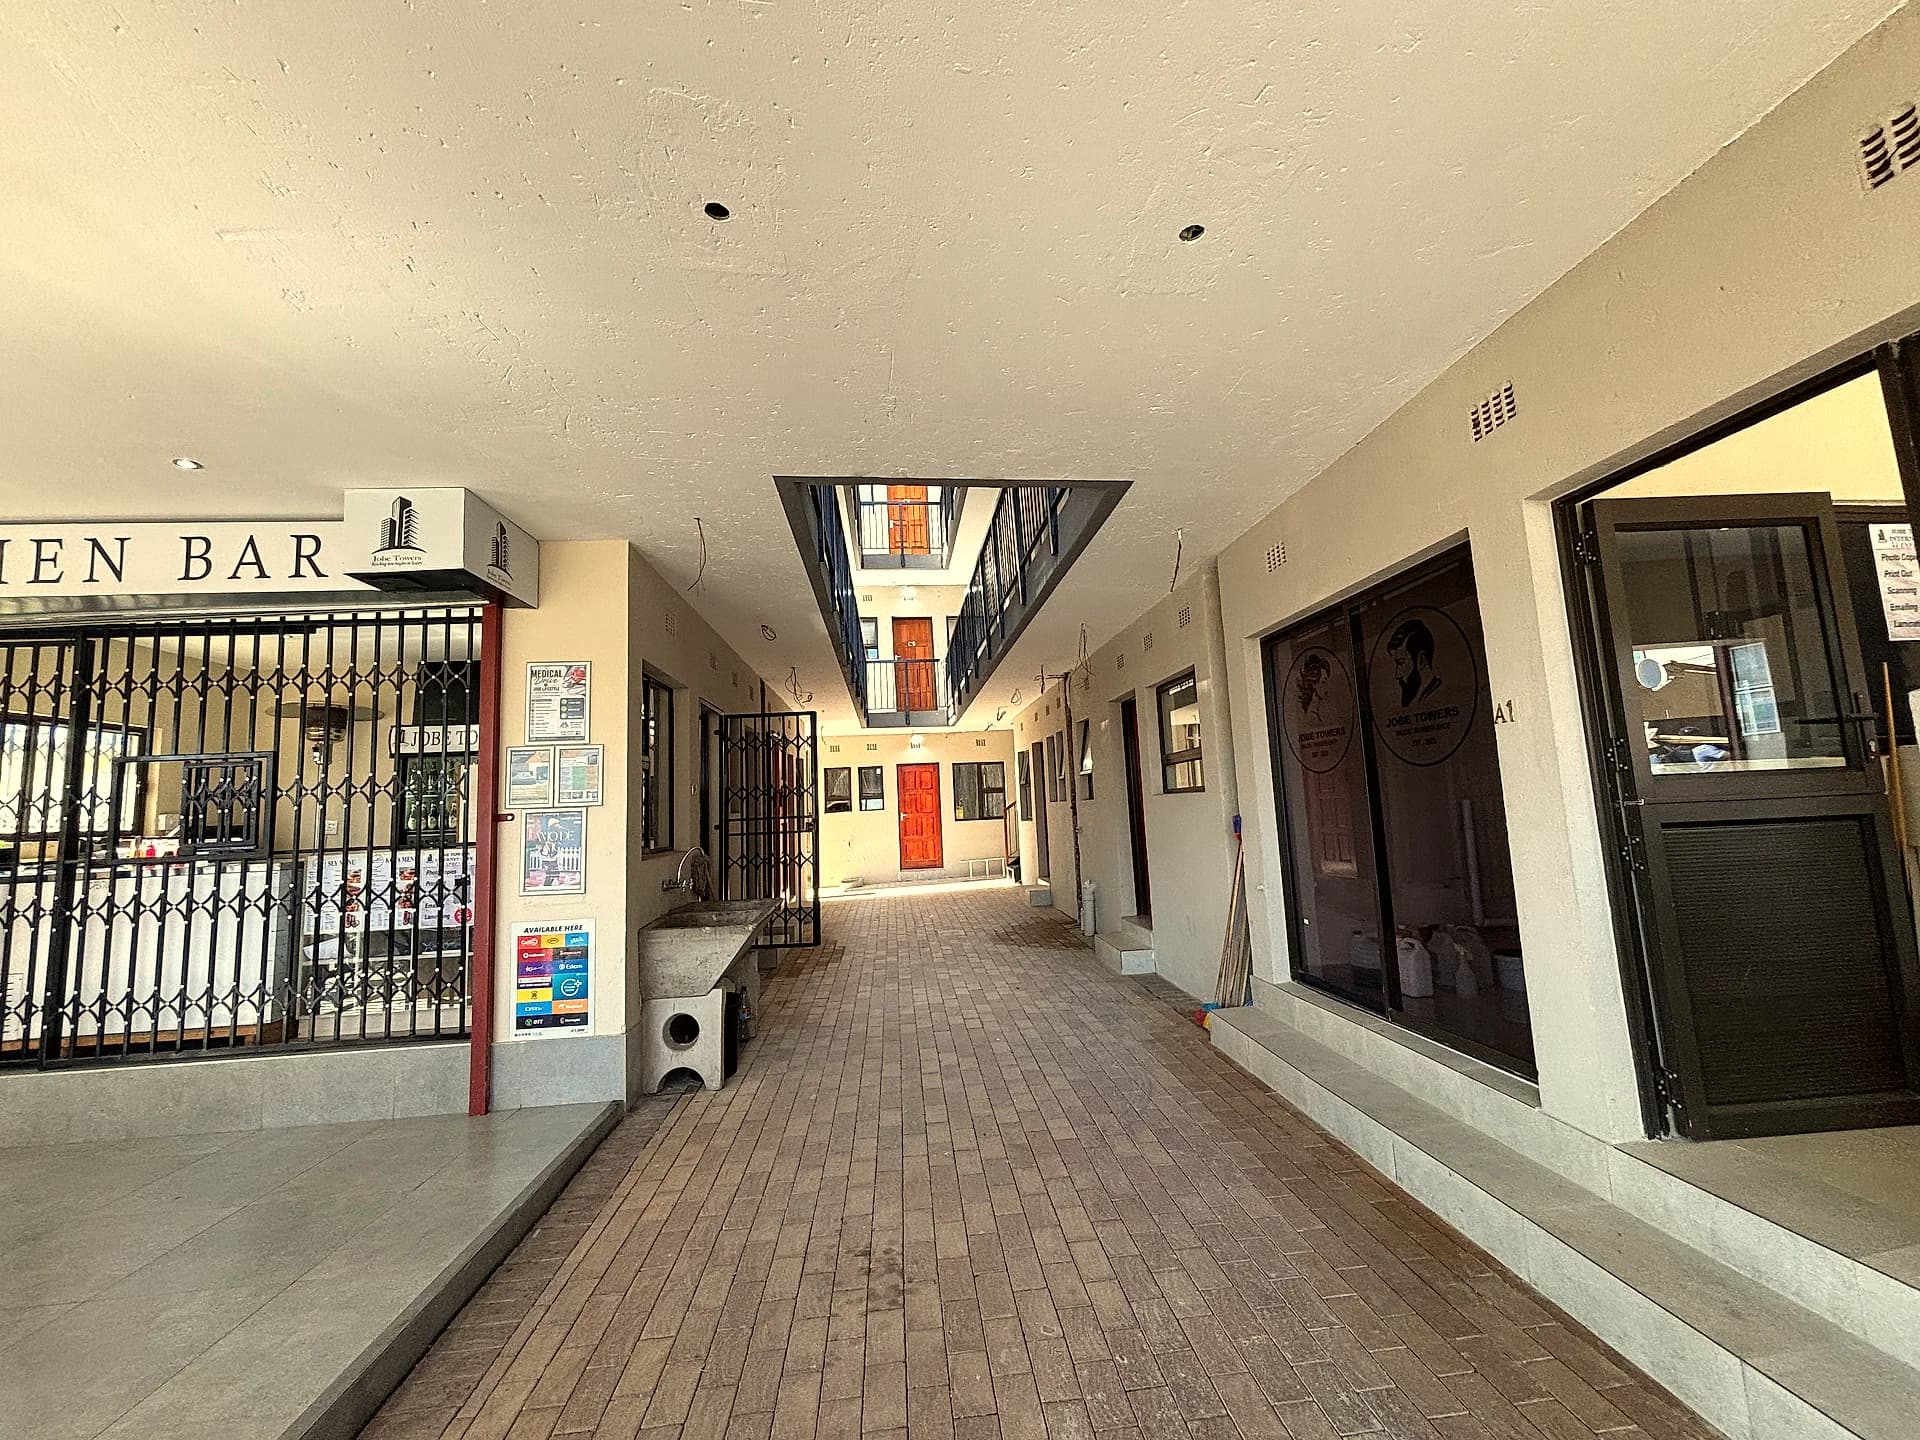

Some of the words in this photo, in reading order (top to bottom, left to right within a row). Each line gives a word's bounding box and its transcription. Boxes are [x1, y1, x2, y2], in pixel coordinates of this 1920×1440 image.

[177, 534, 329, 581] BAR
[1887, 586, 1917, 596] Scanning
[1889, 603, 1919, 613] Emailing
[530, 669, 563, 678] MEDICAL
[1385, 714, 1412, 729] JOBE
[1413, 705, 1460, 724] TOWERS
[1494, 699, 1515, 725] A1
[1315, 726, 1346, 739] TOWERS
[523, 926, 562, 934] AVAILABLE
[564, 924, 584, 932] HERE
